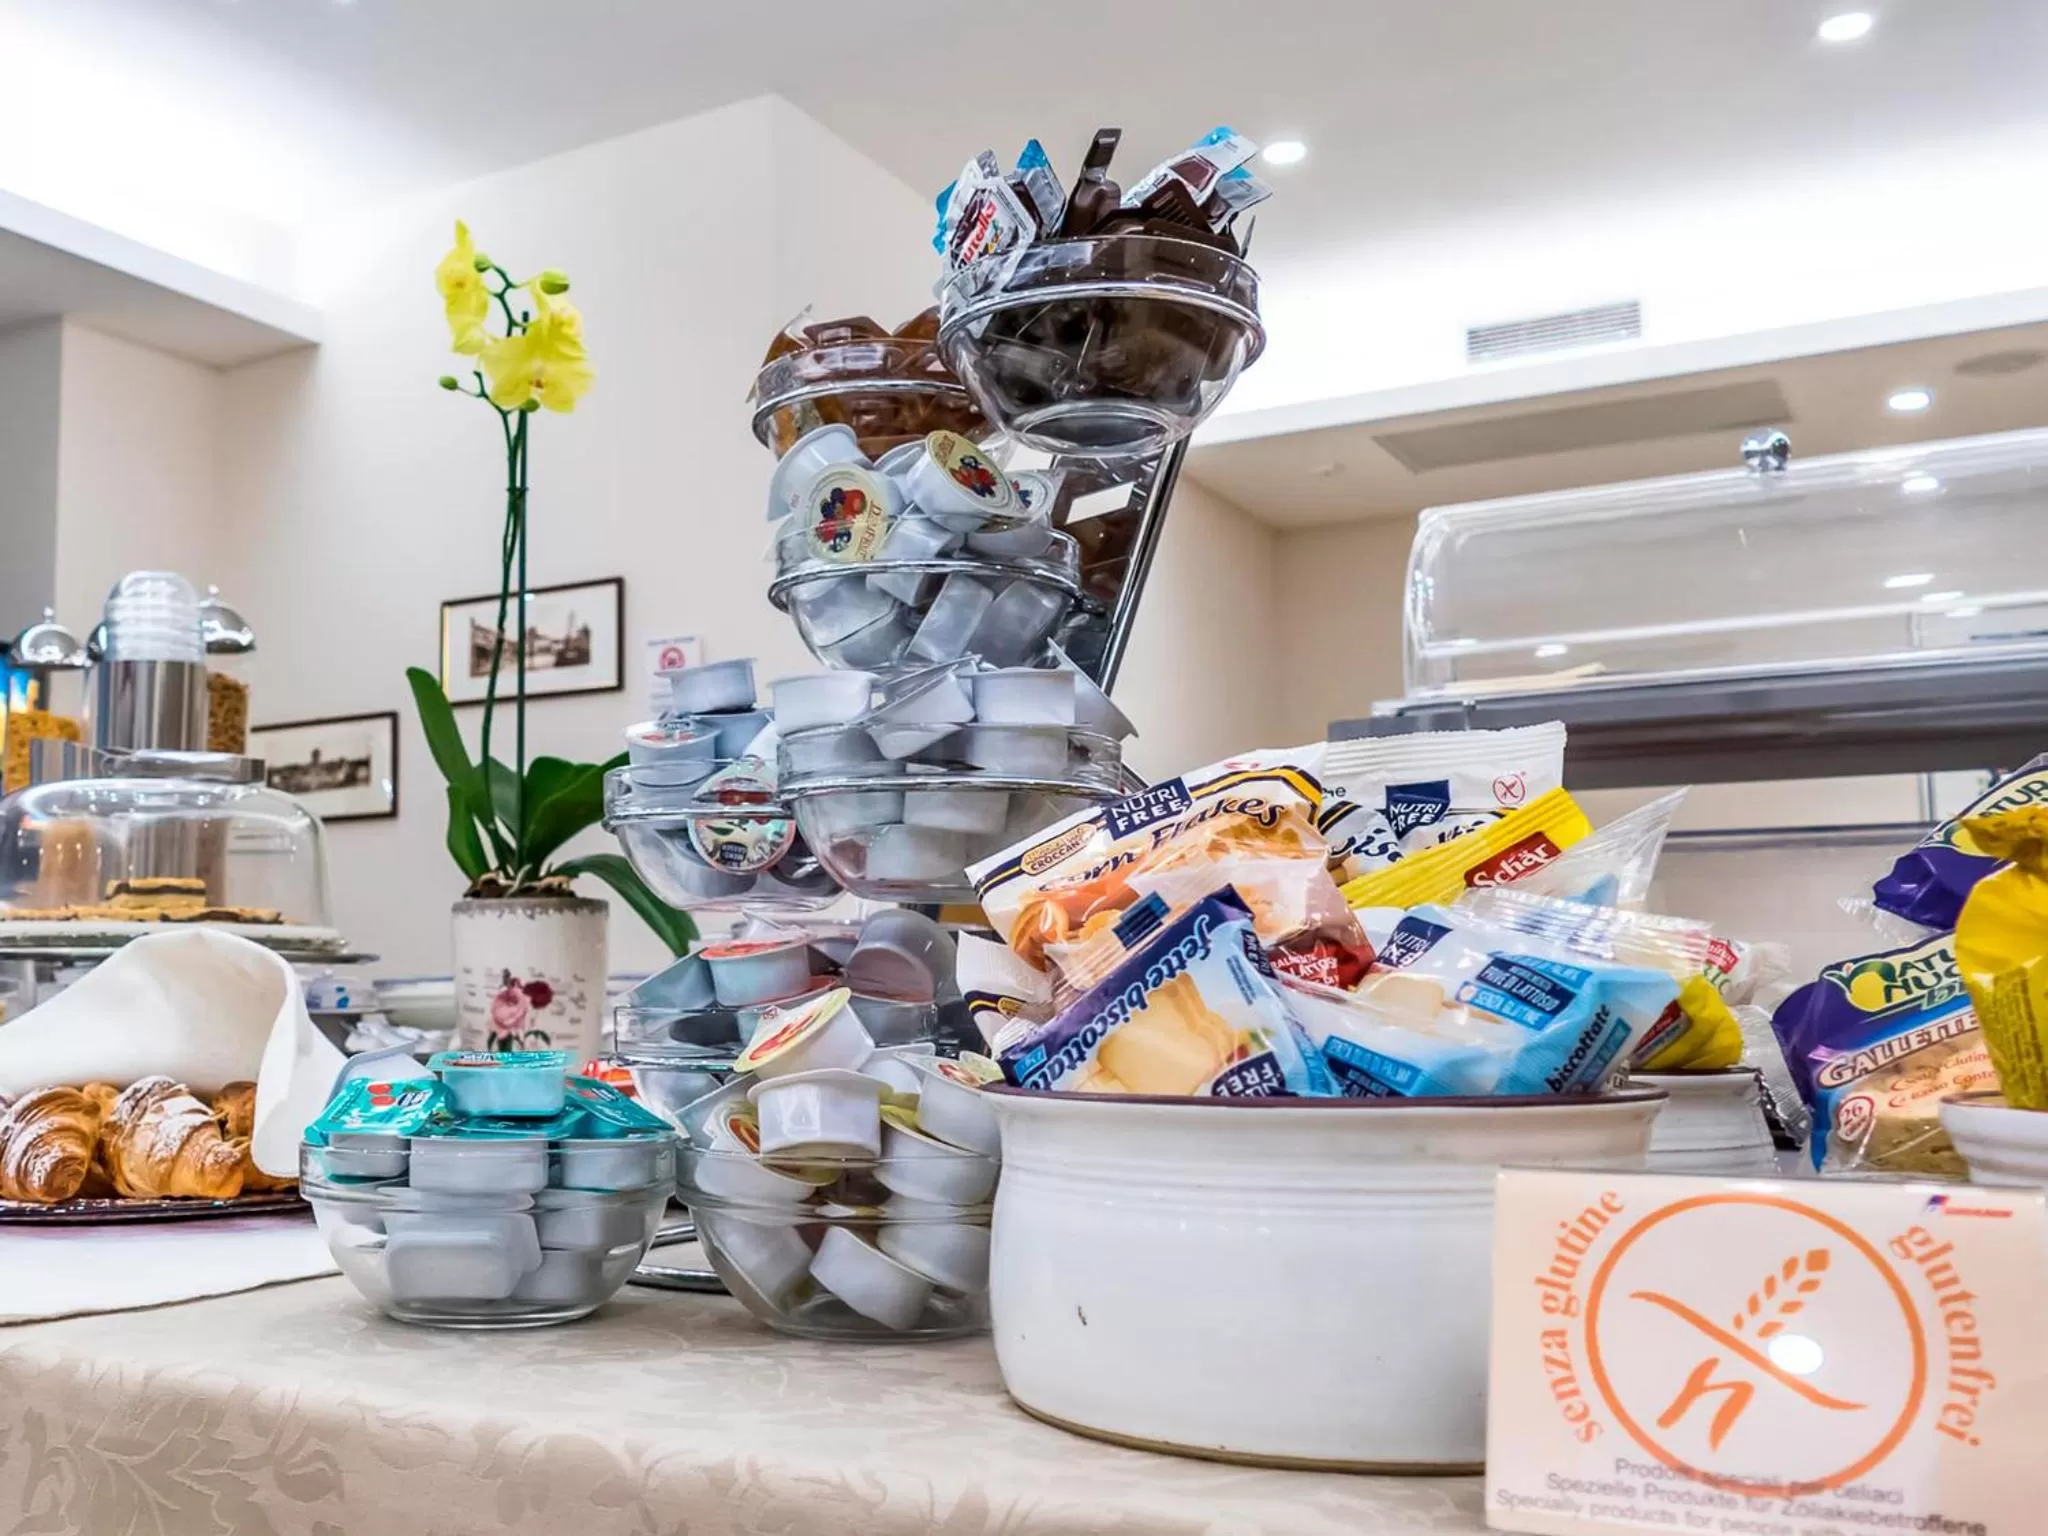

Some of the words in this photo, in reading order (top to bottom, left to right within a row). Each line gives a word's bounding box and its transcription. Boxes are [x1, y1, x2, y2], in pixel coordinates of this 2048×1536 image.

[1110, 784, 1180, 818] NUTRI
[1116, 799, 1190, 833] FREE
[1389, 802, 1441, 819] NUTRI
[1472, 842, 1549, 889] Schär
[1145, 914, 1212, 990] fette
[1534, 1189, 1626, 1319] glutine
[1889, 1224, 1997, 1447] glutenfrei
[1540, 1322, 1604, 1445] senza
[1546, 1472, 1638, 1498] Spezielle
